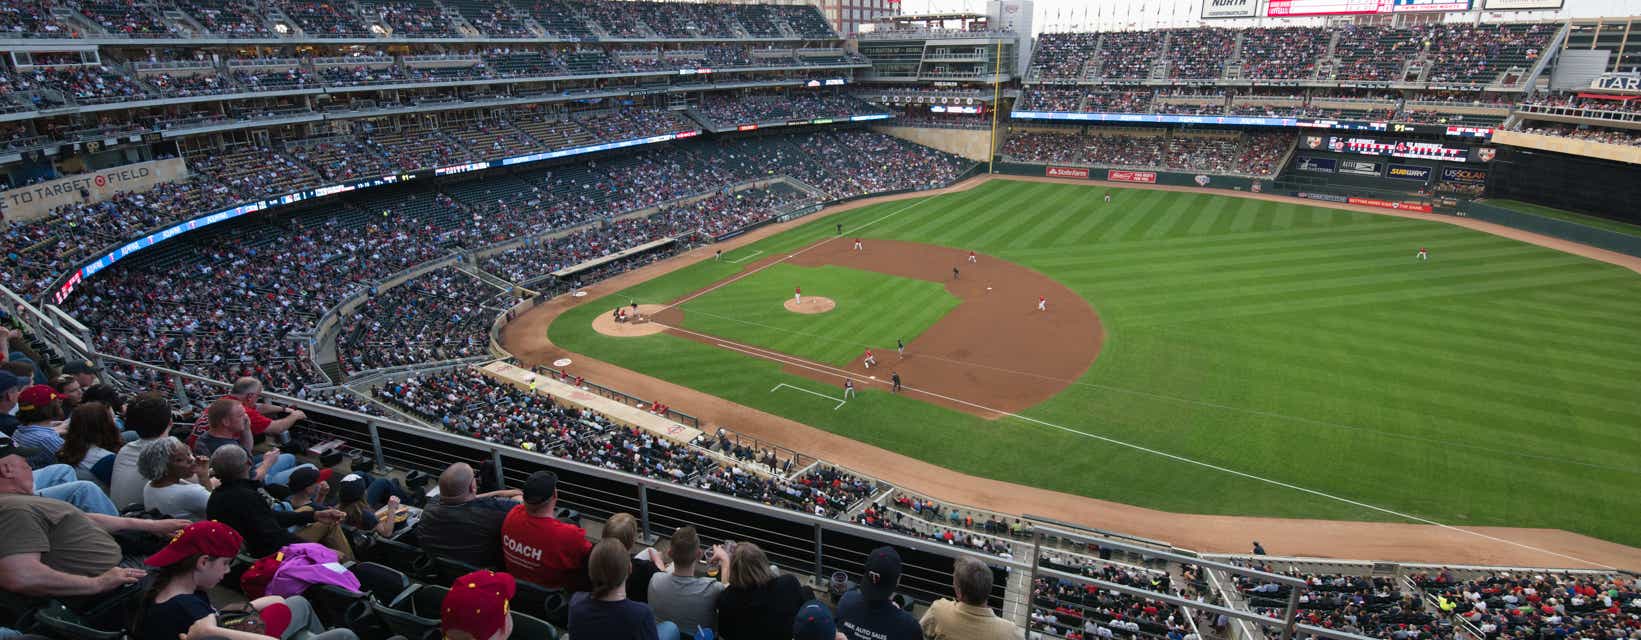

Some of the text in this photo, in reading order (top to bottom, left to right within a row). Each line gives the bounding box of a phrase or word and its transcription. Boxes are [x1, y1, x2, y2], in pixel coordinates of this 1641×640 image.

[1394, 124, 1405, 132] 91
[1390, 168, 1427, 177] SUBWAY
[10, 192, 32, 206] TO
[34, 178, 91, 199] TARGET
[108, 167, 149, 184] FIELD
[503, 535, 542, 560] COACH
[856, 626, 871, 636] AUTO
